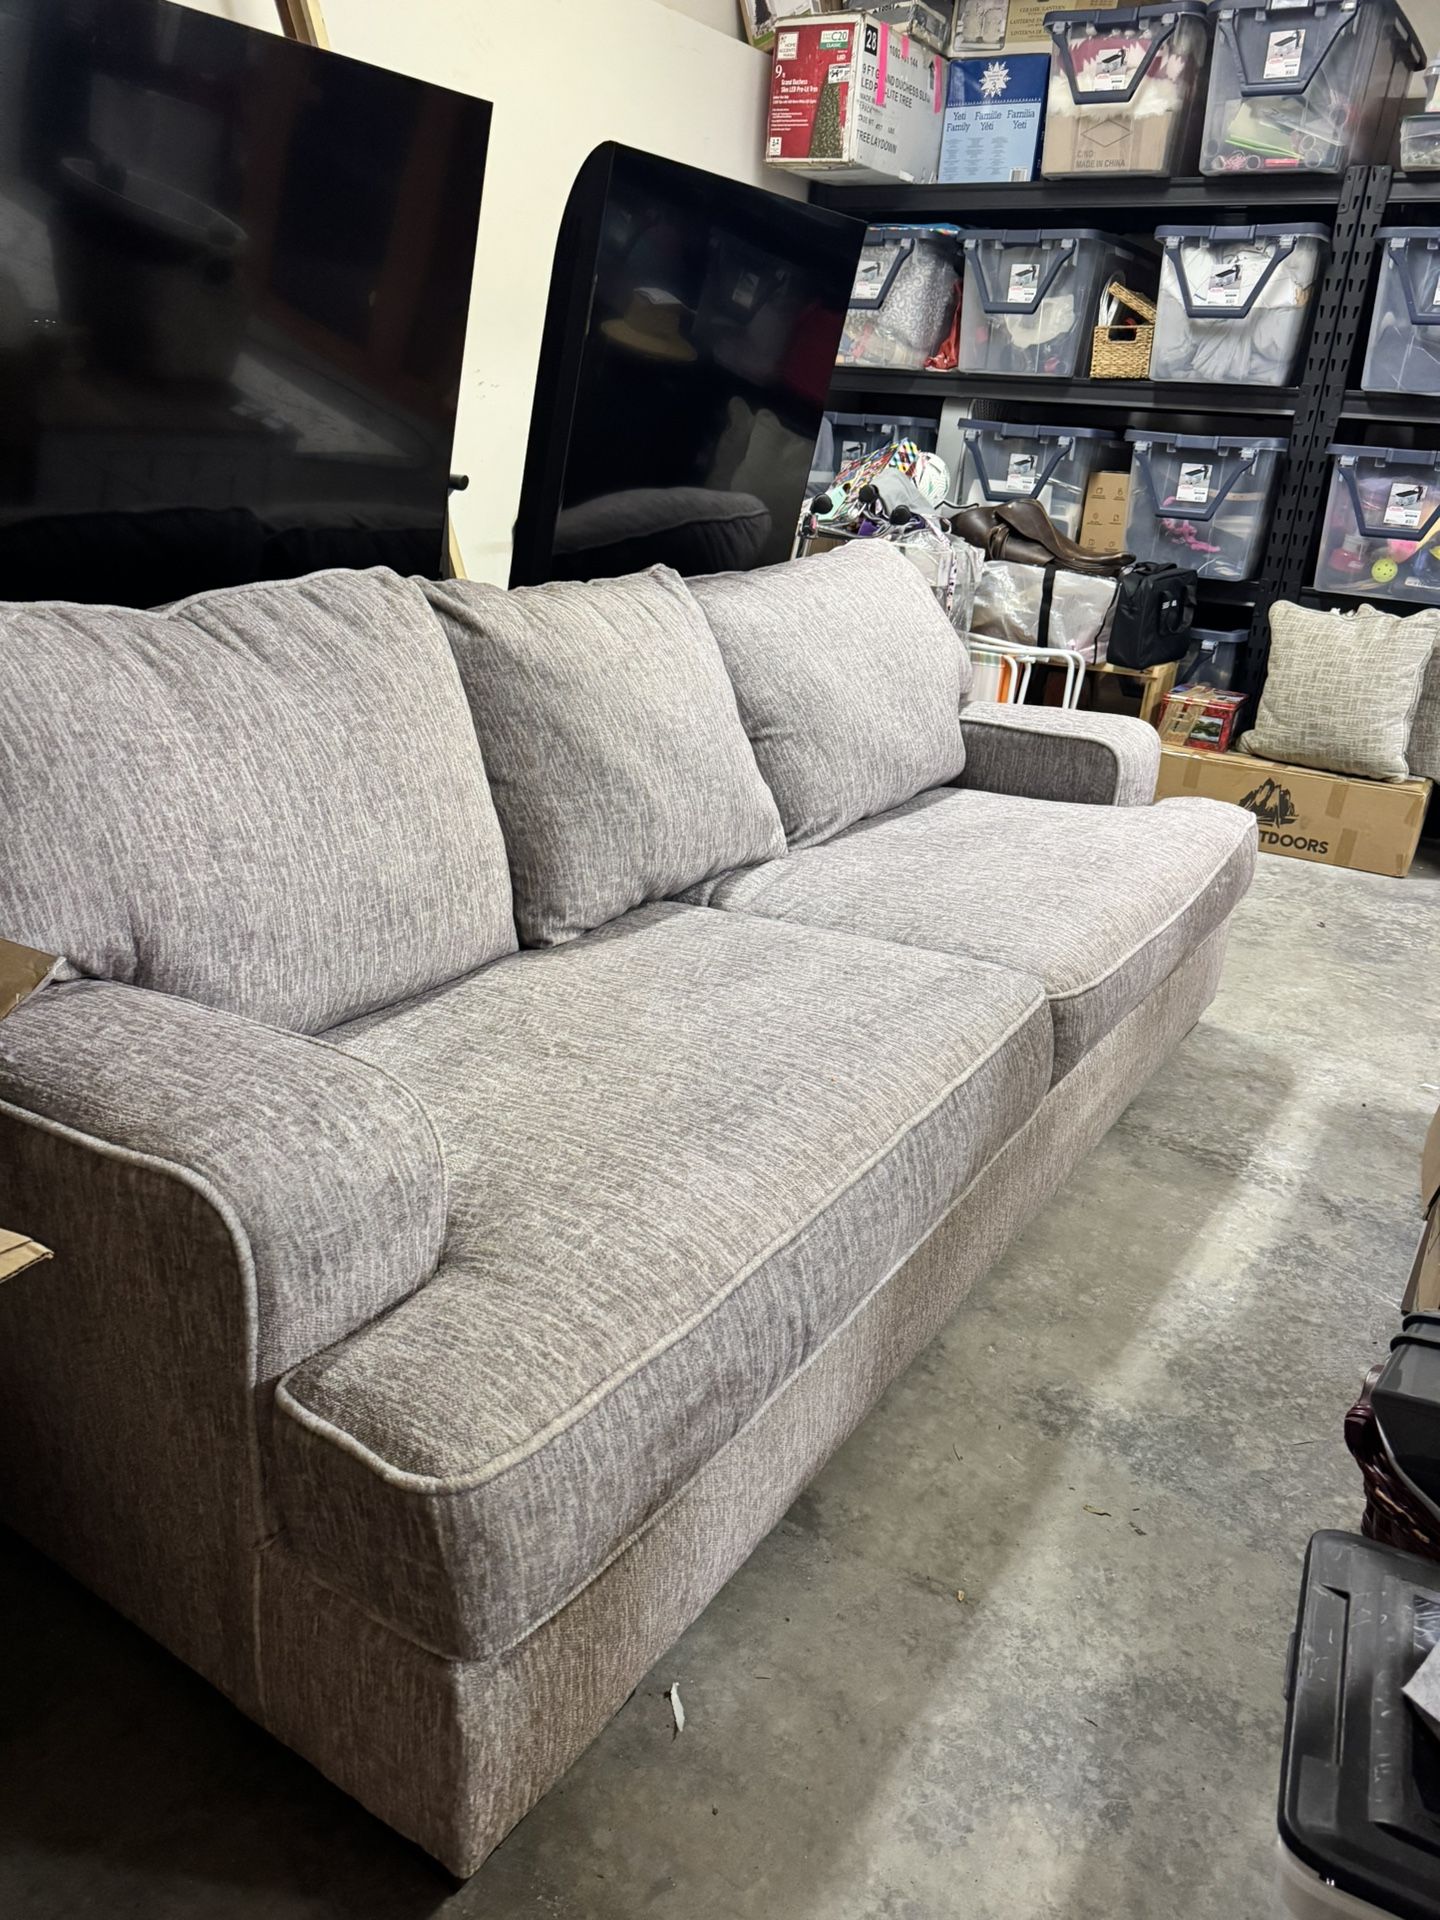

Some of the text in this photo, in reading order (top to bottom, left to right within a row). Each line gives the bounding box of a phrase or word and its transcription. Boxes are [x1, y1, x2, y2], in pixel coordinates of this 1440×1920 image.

[831, 31, 848, 41] C20
[865, 30, 877, 51] 28
[775, 64, 783, 79] 9
[862, 63, 867, 74] 9
[867, 64, 875, 77] FT
[861, 77, 874, 91] LED
[899, 93, 913, 109] TREE
[953, 111, 967, 121] Yeti
[975, 111, 1002, 121] Famille
[1007, 109, 1035, 119] Familia
[947, 123, 971, 133] Family
[1013, 120, 1027, 129] Yeti
[856, 129, 898, 154] TREE LAYDOWN
[1104, 158, 1126, 167] CHINA
[1258, 830, 1329, 854] TDOORS
